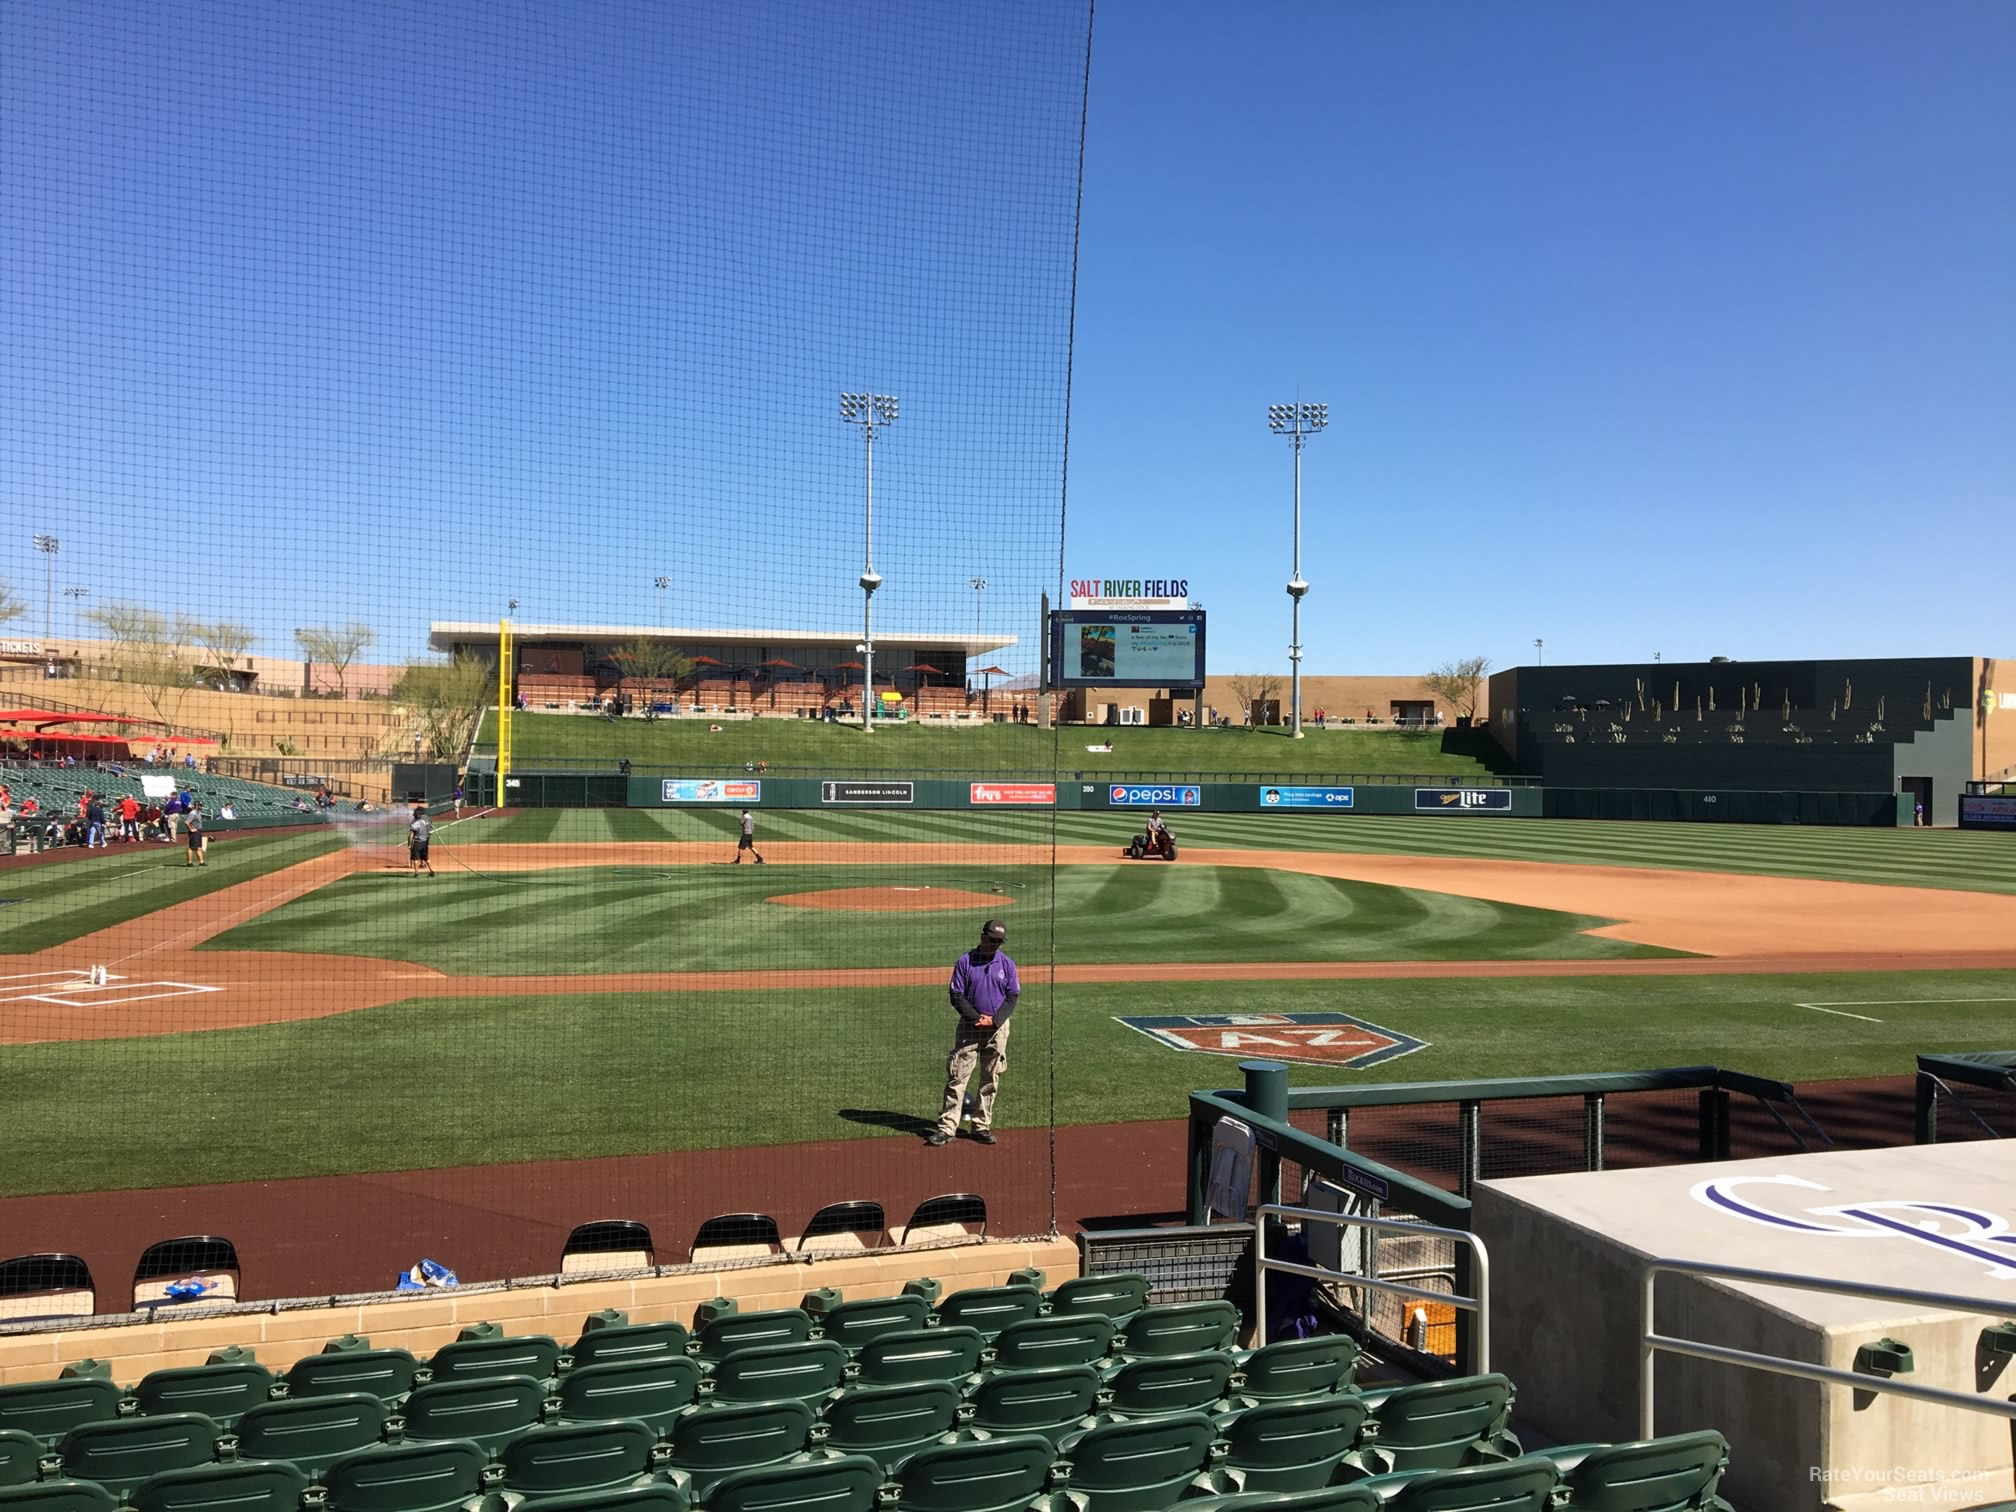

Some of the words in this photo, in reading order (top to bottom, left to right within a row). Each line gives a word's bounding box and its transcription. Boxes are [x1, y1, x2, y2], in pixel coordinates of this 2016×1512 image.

[1070, 580, 1101, 598] SALT
[1104, 580, 1141, 598] RIVER
[1144, 580, 1188, 598] FIELDS
[1109, 614, 1152, 623] #RoxSpring
[1, 641, 41, 654] TICKETS
[505, 779, 521, 788] 345
[1129, 788, 1176, 803] pepsi
[1334, 794, 1350, 802] aps
[1459, 791, 1487, 808] Lite
[1703, 795, 1717, 803] 410
